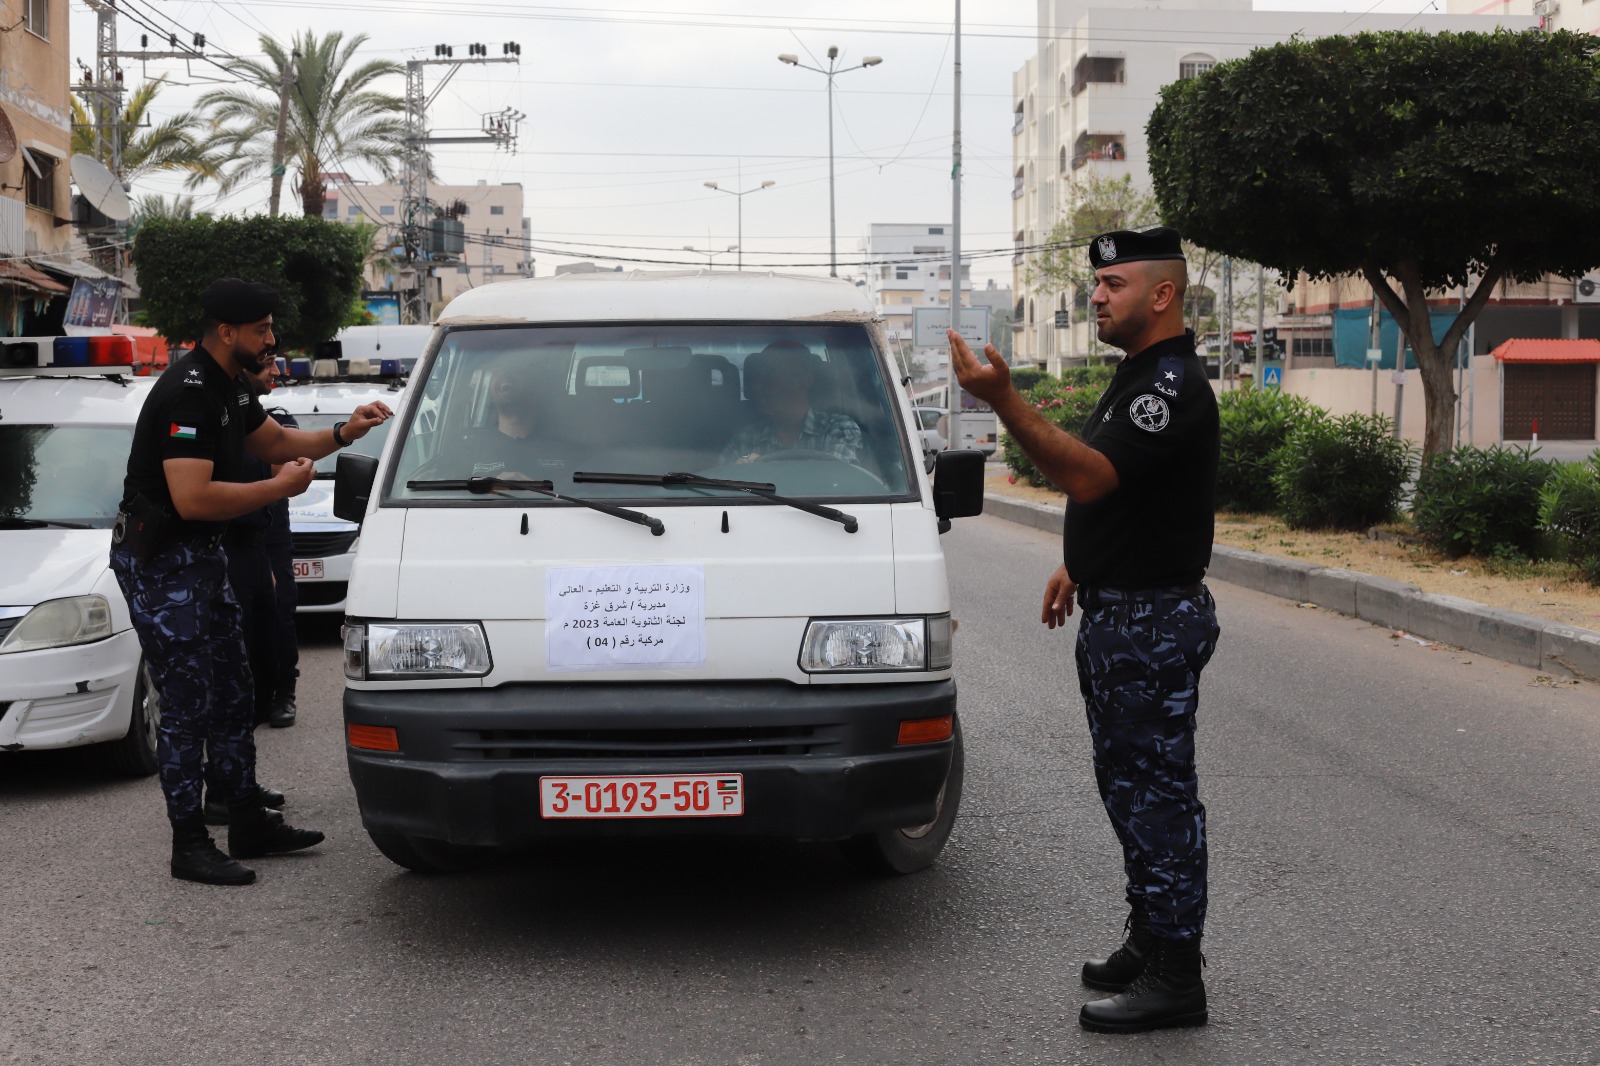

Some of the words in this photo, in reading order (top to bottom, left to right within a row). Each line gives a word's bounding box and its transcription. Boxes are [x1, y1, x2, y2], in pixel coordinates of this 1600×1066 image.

[558, 585, 584, 598] العالي
[595, 583, 622, 596] التعليم
[624, 586, 632, 595] و
[634, 582, 662, 595] التربية
[665, 582, 691, 594] وزارة
[583, 601, 601, 613] غزة
[604, 600, 628, 613] شرق
[629, 600, 635, 611] /
[637, 599, 667, 611] مديرية
[563, 622, 569, 630] م
[572, 619, 600, 629] 2023
[602, 617, 628, 627] العامة
[631, 616, 663, 628] الثانوية
[665, 615, 686, 628] لجنة
[619, 635, 635, 648] رقم
[637, 634, 664, 647] مركبة
[552, 781, 709, 812] 3-0193-50
[722, 796, 734, 811] P
